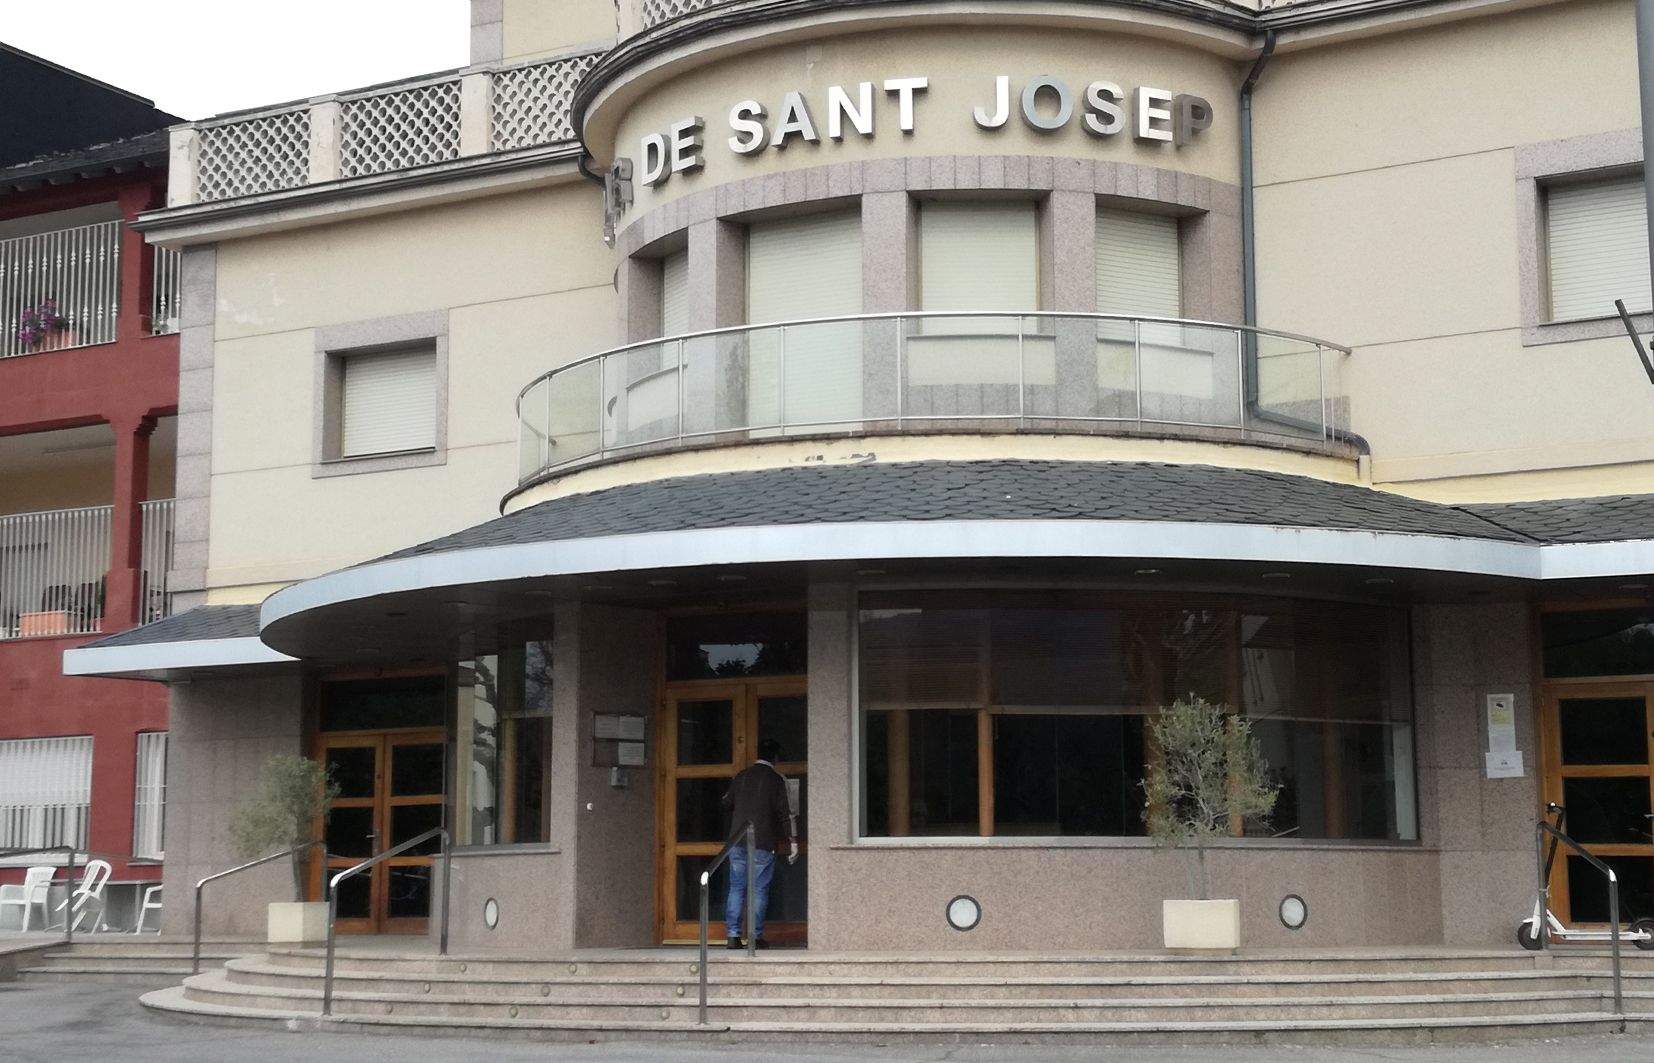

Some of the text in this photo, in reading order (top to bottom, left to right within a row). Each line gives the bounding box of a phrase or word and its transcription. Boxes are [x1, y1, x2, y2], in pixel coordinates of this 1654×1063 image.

[641, 75, 1213, 187] DE SANT JOSEP
